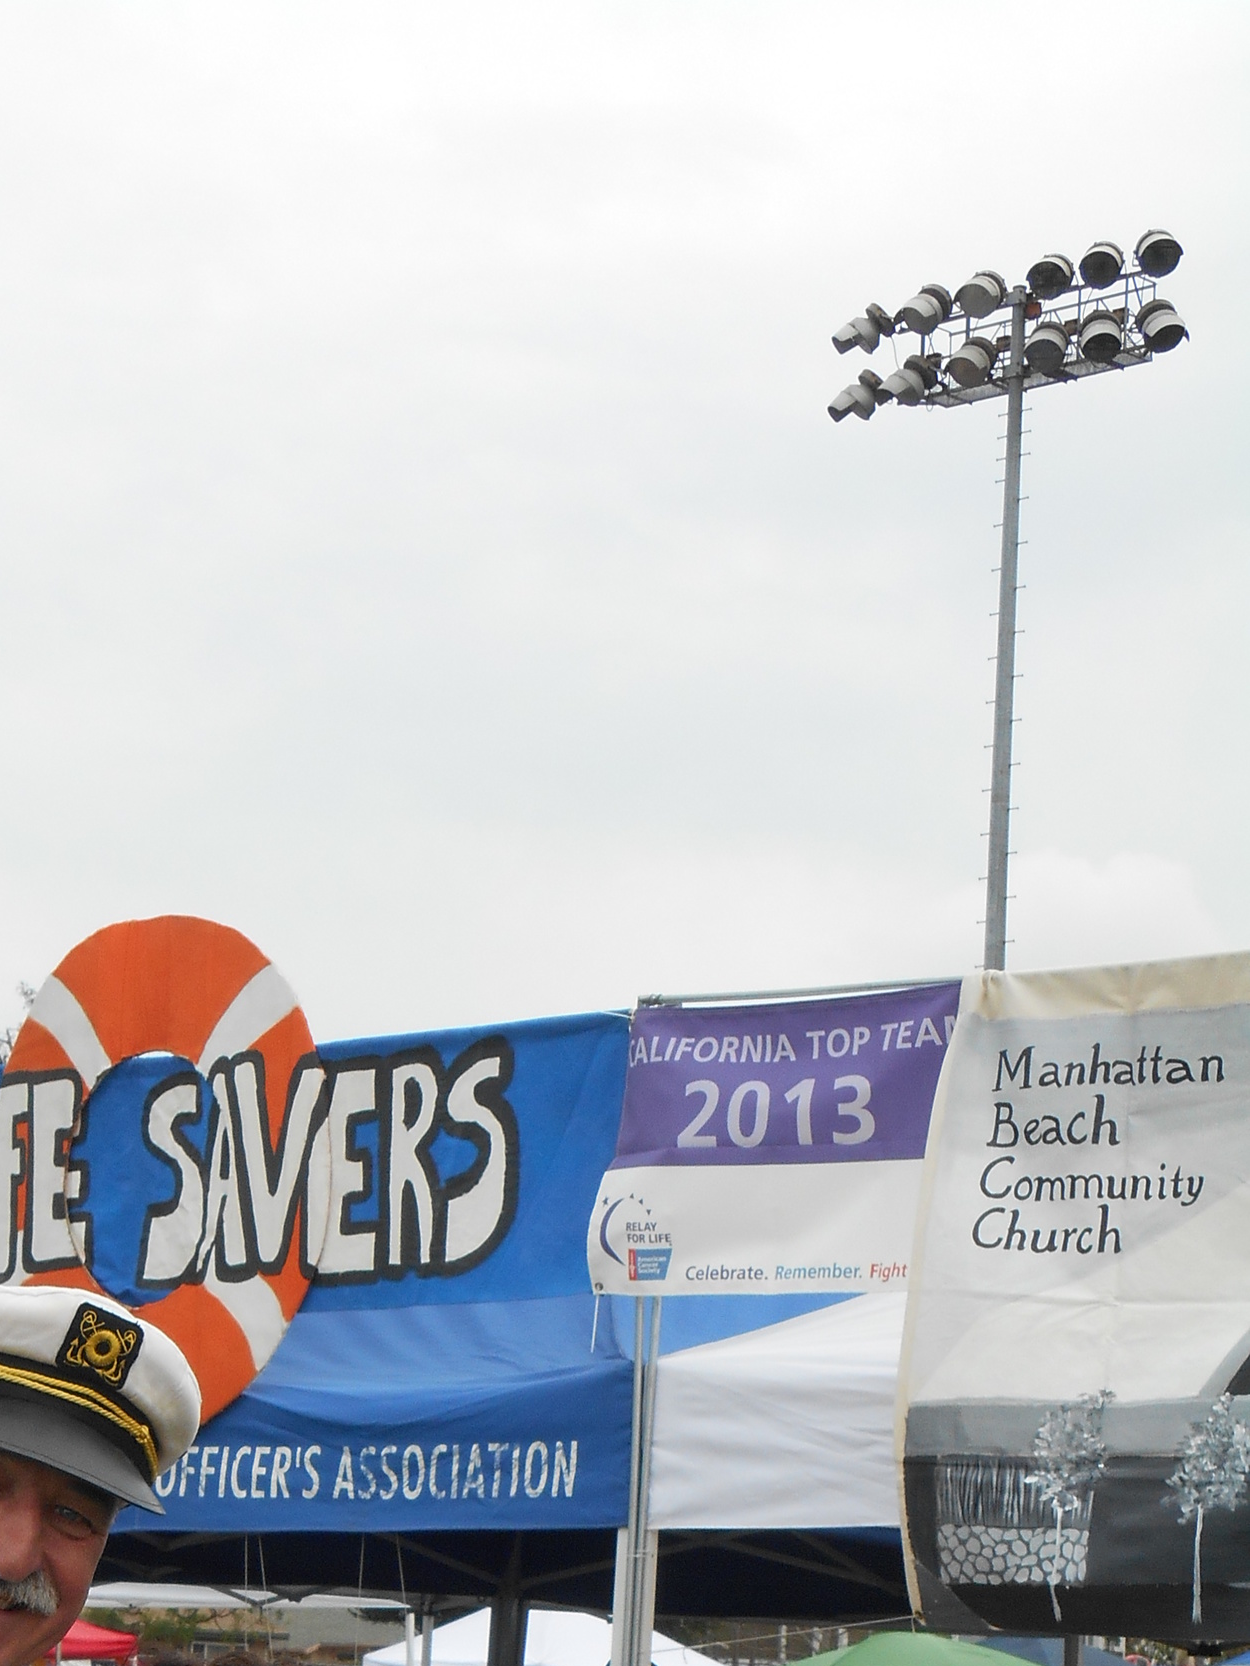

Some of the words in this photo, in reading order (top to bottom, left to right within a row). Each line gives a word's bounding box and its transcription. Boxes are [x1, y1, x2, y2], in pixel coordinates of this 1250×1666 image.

[806, 1026, 871, 1060] TOP
[991, 1043, 1225, 1092] Manhattan
[677, 1074, 877, 1149] 2013
[986, 1094, 1121, 1148] Beach
[135, 1033, 520, 1290] SAVERS
[980, 1156, 1205, 1207] Community
[626, 1221, 657, 1232] RELAY
[627, 1233, 646, 1243] FOR
[649, 1233, 672, 1244] LIFE
[972, 1203, 1122, 1254] Church
[685, 1265, 768, 1281] Celebrate.
[775, 1264, 863, 1280] Remember.
[869, 1262, 908, 1282] Fight
[156, 1445, 322, 1500] OFFICER'S
[332, 1440, 579, 1500] ASSOCIATION
